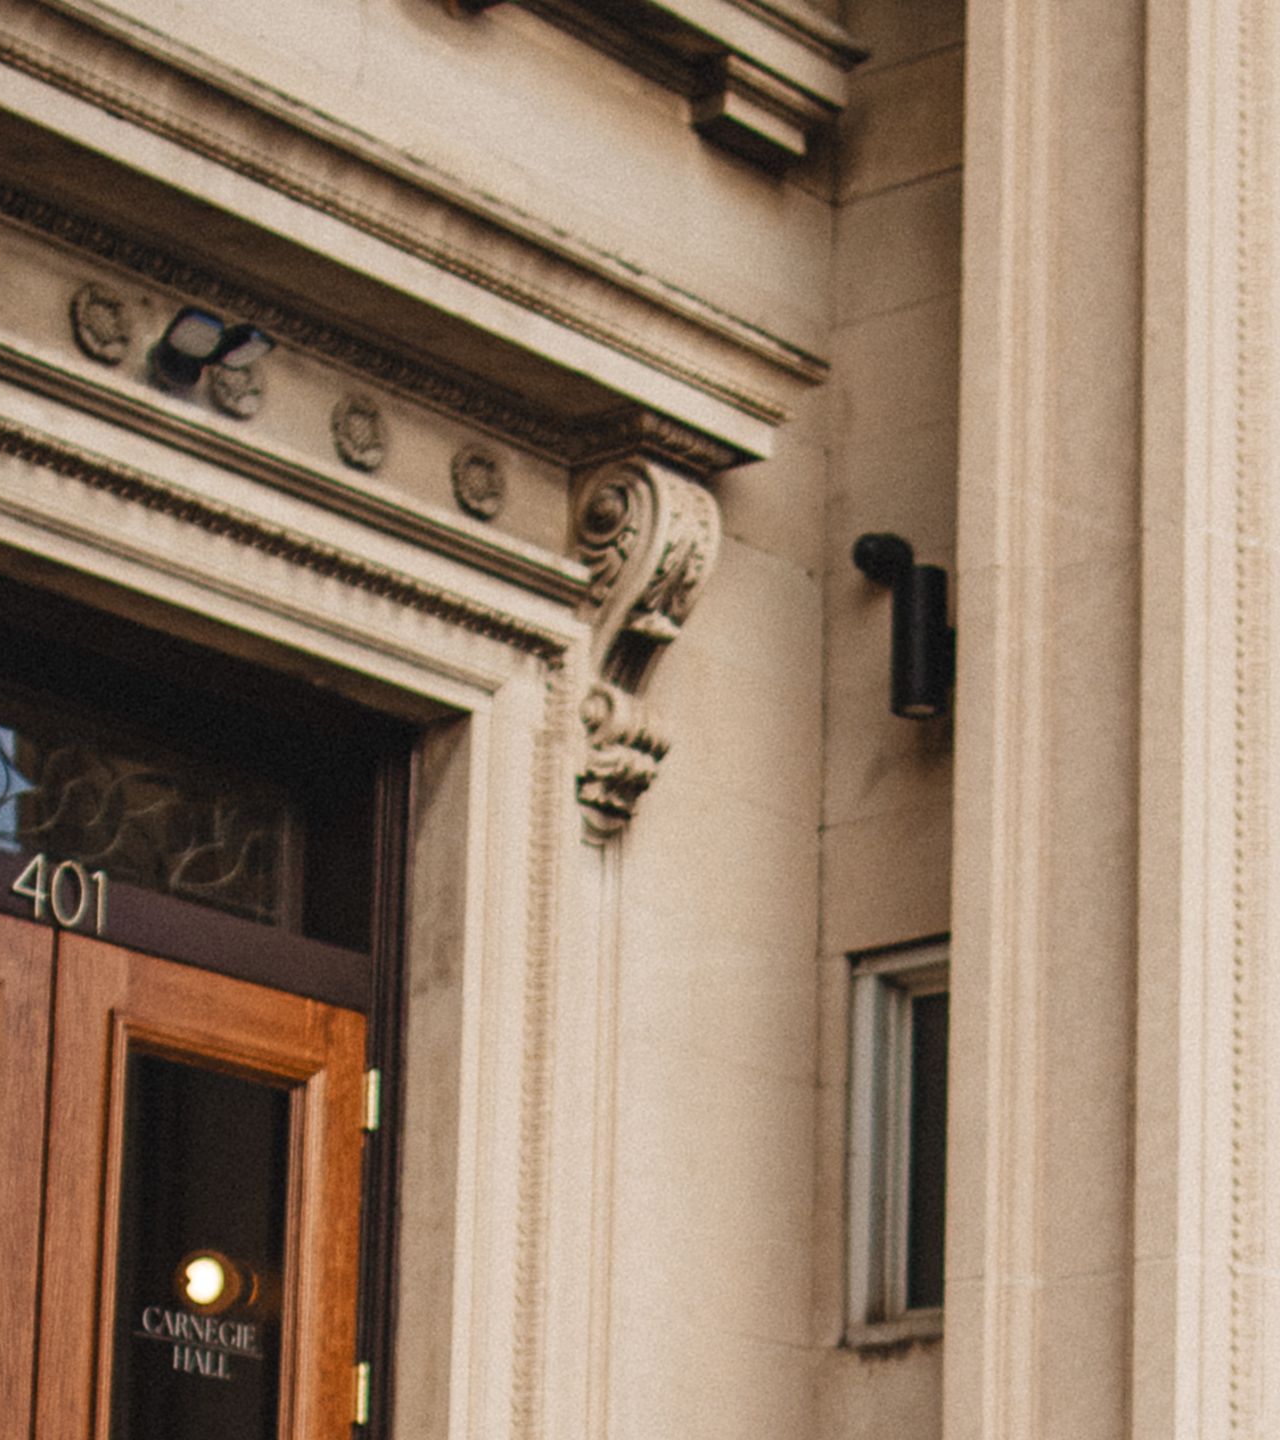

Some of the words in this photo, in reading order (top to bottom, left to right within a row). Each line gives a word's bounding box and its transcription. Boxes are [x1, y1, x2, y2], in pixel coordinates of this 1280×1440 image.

[12, 853, 106, 935] 401
[142, 1306, 257, 1352] CARNEGIE
[172, 1344, 231, 1380] HALL
